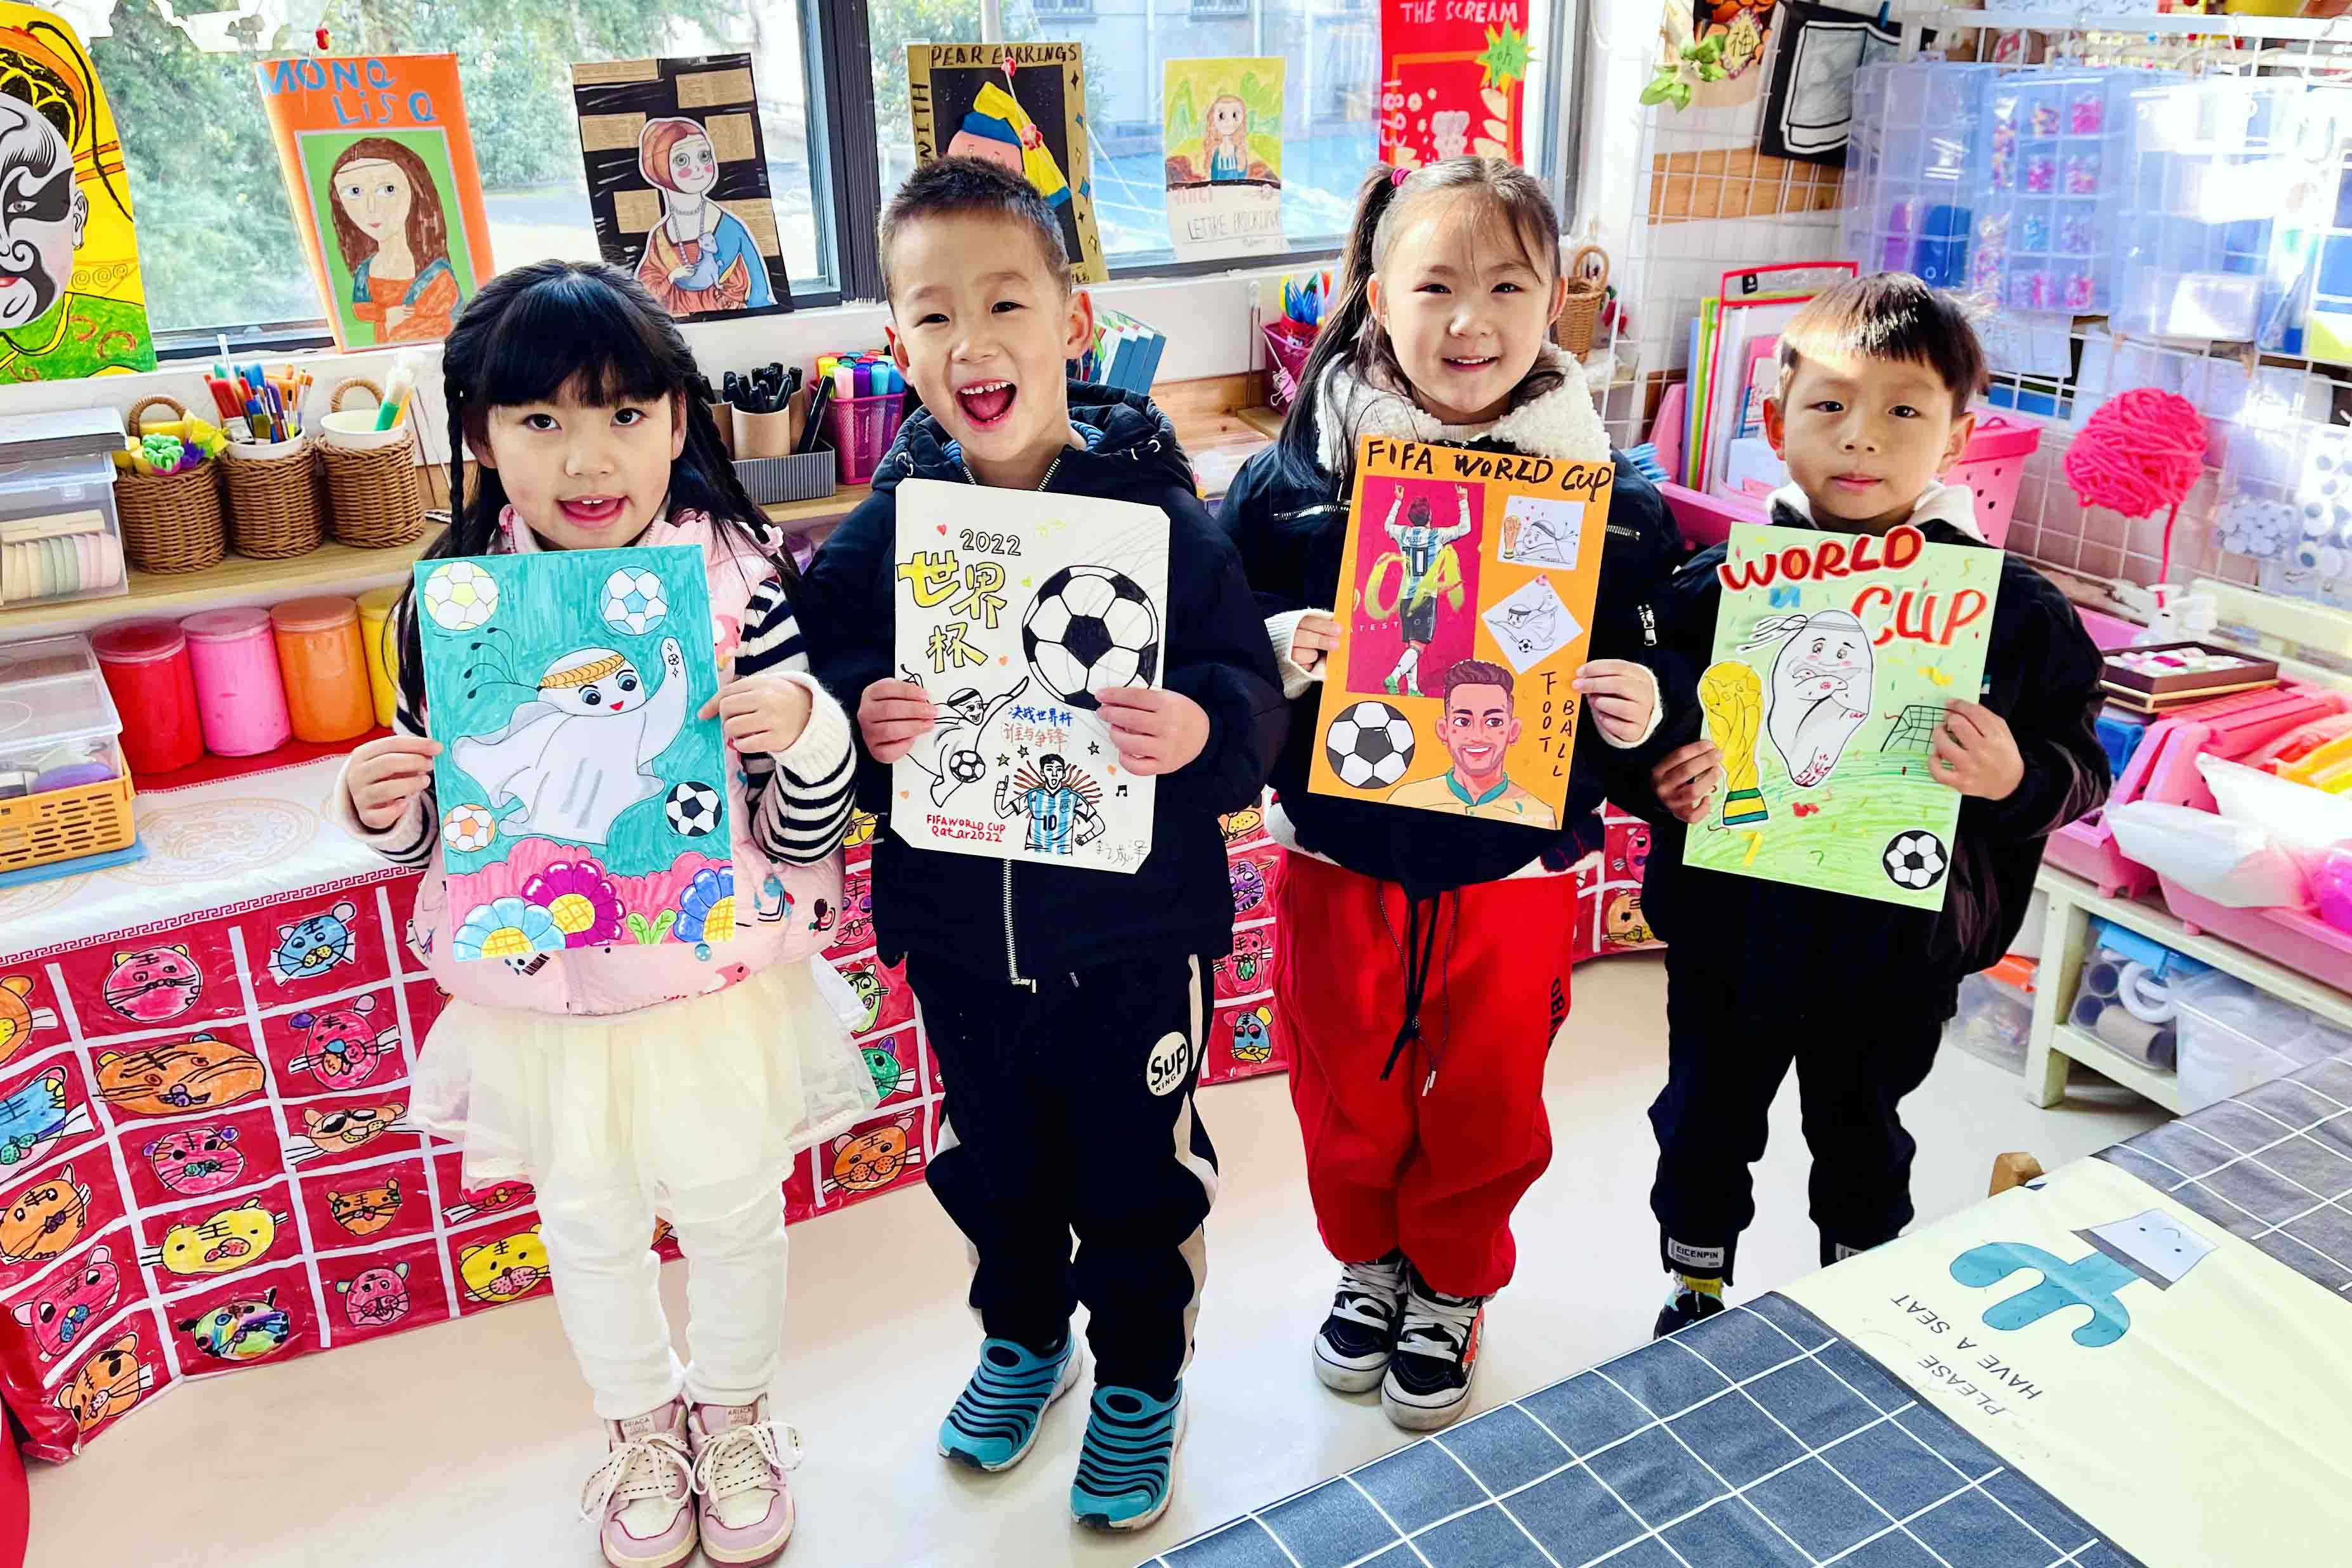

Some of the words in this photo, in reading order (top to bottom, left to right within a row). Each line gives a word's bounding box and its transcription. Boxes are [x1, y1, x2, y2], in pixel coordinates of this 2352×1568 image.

[1401, 2, 1435, 23] THE
[1446, 1, 1518, 23] SCREAM
[931, 46, 983, 67] PEAR
[1367, 440, 1434, 474] FIFA
[1454, 455, 1553, 484] WORLD
[960, 529, 1022, 556] 2022
[1719, 525, 1923, 592] WORLD
[897, 550, 1007, 629] 世界
[1850, 584, 1987, 647] CUP
[926, 622, 989, 674] 杯
[1043, 814, 1057, 831] 10
[1151, 1043, 1187, 1086] SUP
[1156, 1074, 1176, 1092] KING
[1890, 1295, 1951, 1334] SEAT
[1956, 1336, 1978, 1350] A
[1917, 1354, 2007, 1415] PLEASE
[1976, 1354, 2043, 1399] HAVE
